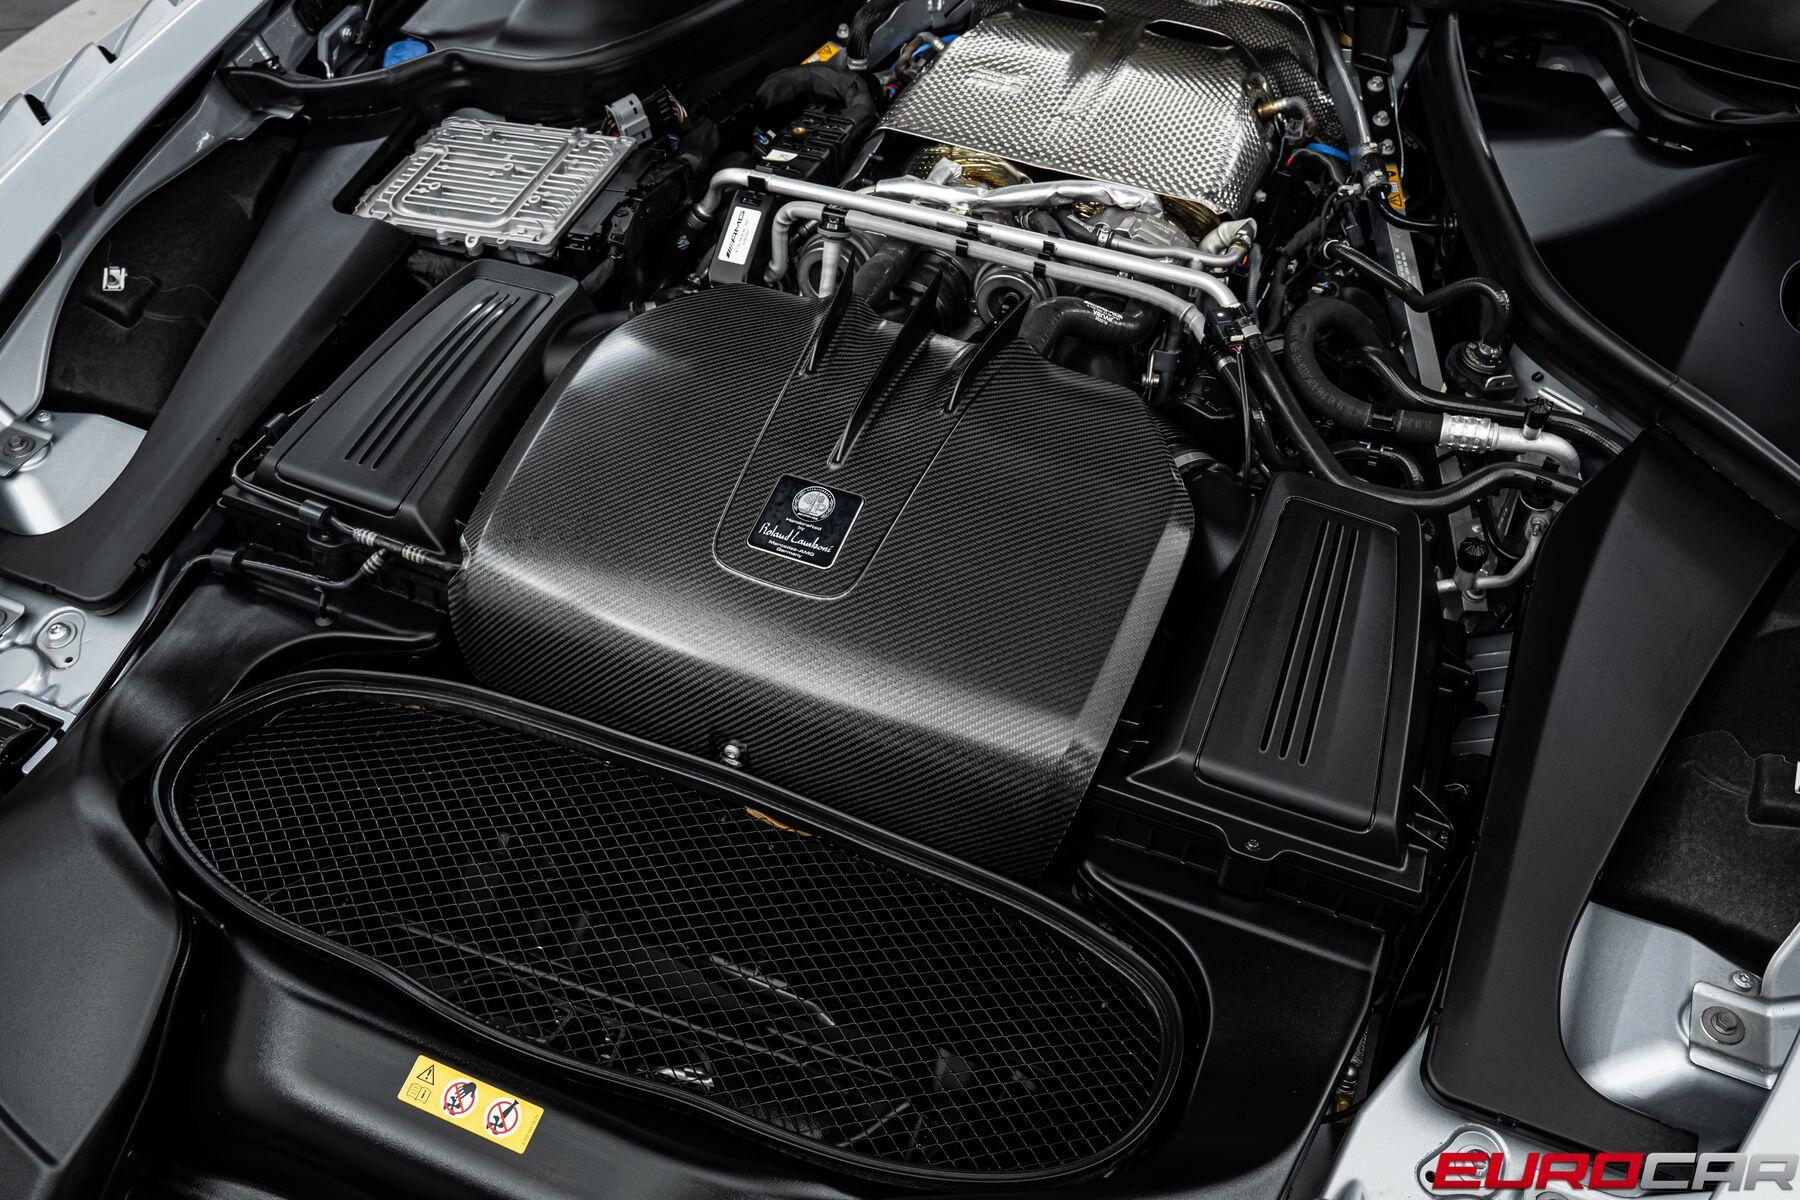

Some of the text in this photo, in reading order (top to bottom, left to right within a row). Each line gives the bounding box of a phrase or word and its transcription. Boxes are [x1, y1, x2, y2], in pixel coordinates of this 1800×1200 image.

[732, 210, 745, 243] AMG
[758, 522, 794, 541] Roland
[785, 517, 822, 531] Handcrafted
[768, 539, 815, 557] Mercedes-AMG
[776, 547, 803, 558] Germany
